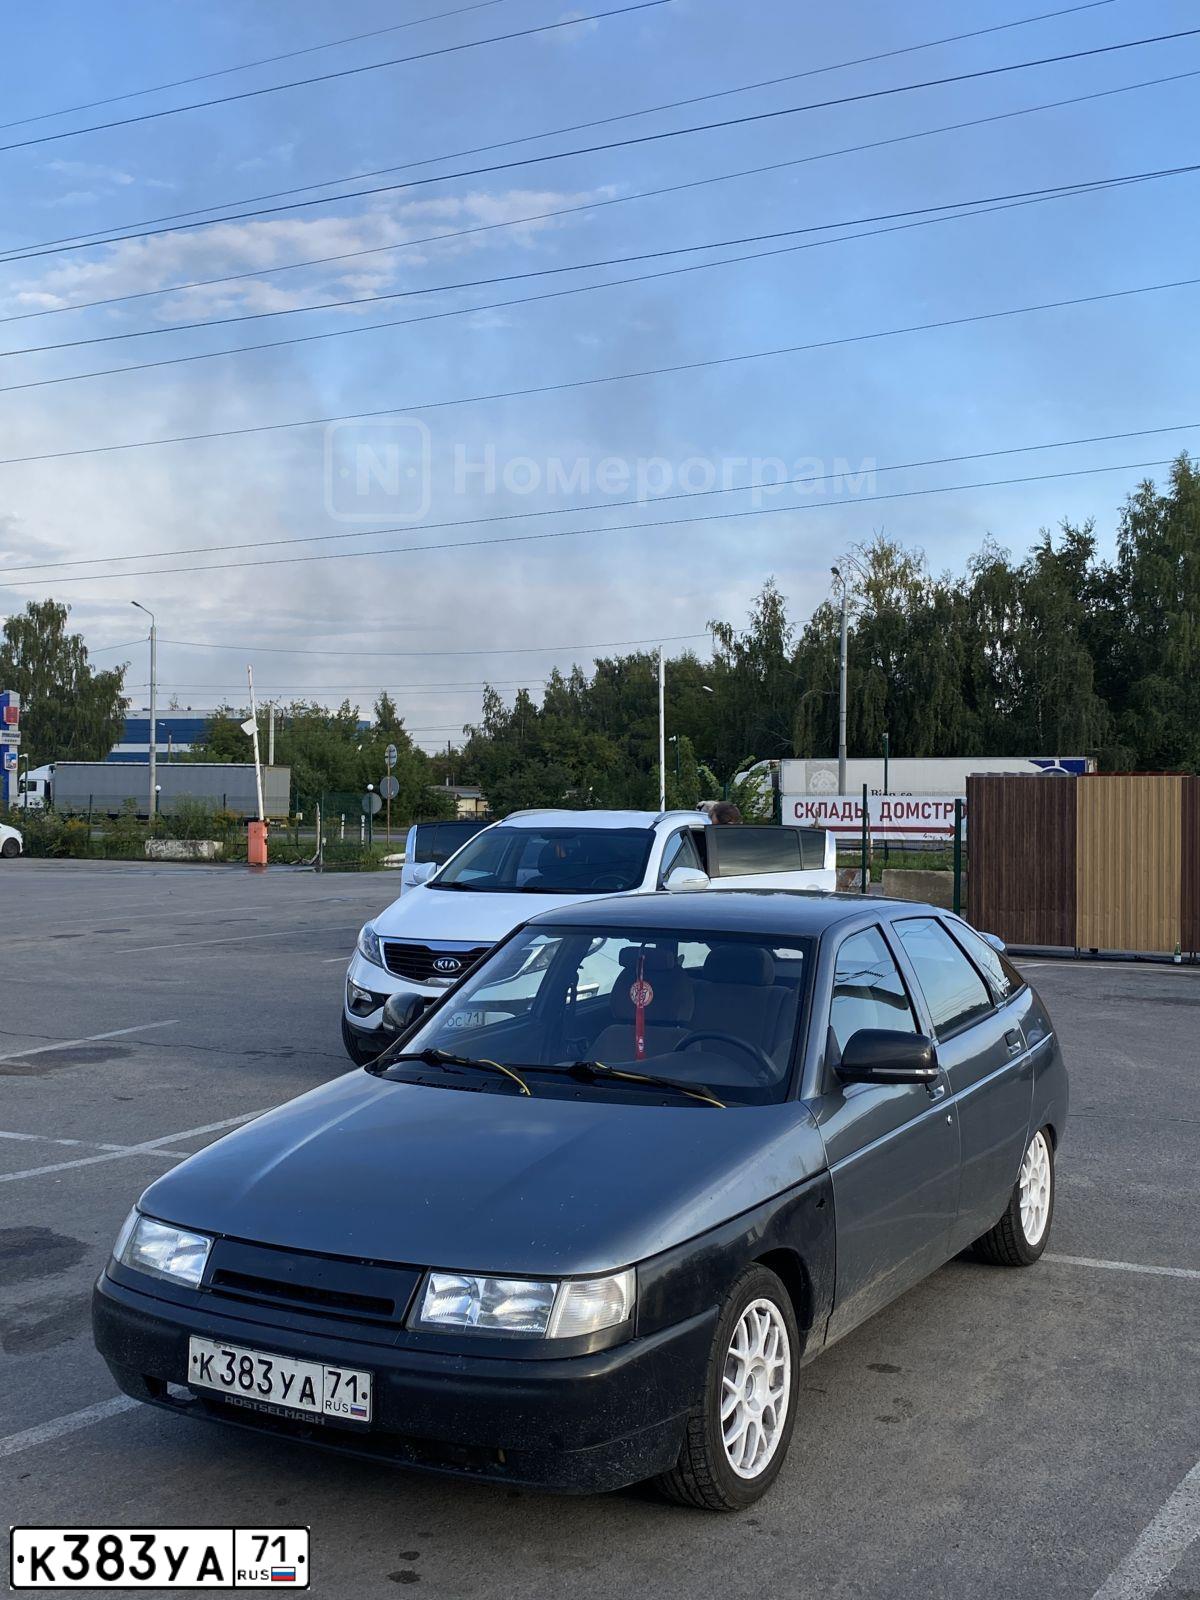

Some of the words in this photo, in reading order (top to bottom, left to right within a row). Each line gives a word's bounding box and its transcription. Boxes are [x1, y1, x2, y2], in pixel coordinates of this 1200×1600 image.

[437, 960, 456, 969] KIA
[200, 1350, 316, 1406] К383УА
[327, 1370, 357, 1403] 71
[224, 1395, 326, 1426] ROSTSELMASH
[325, 1400, 349, 1413] RUS
